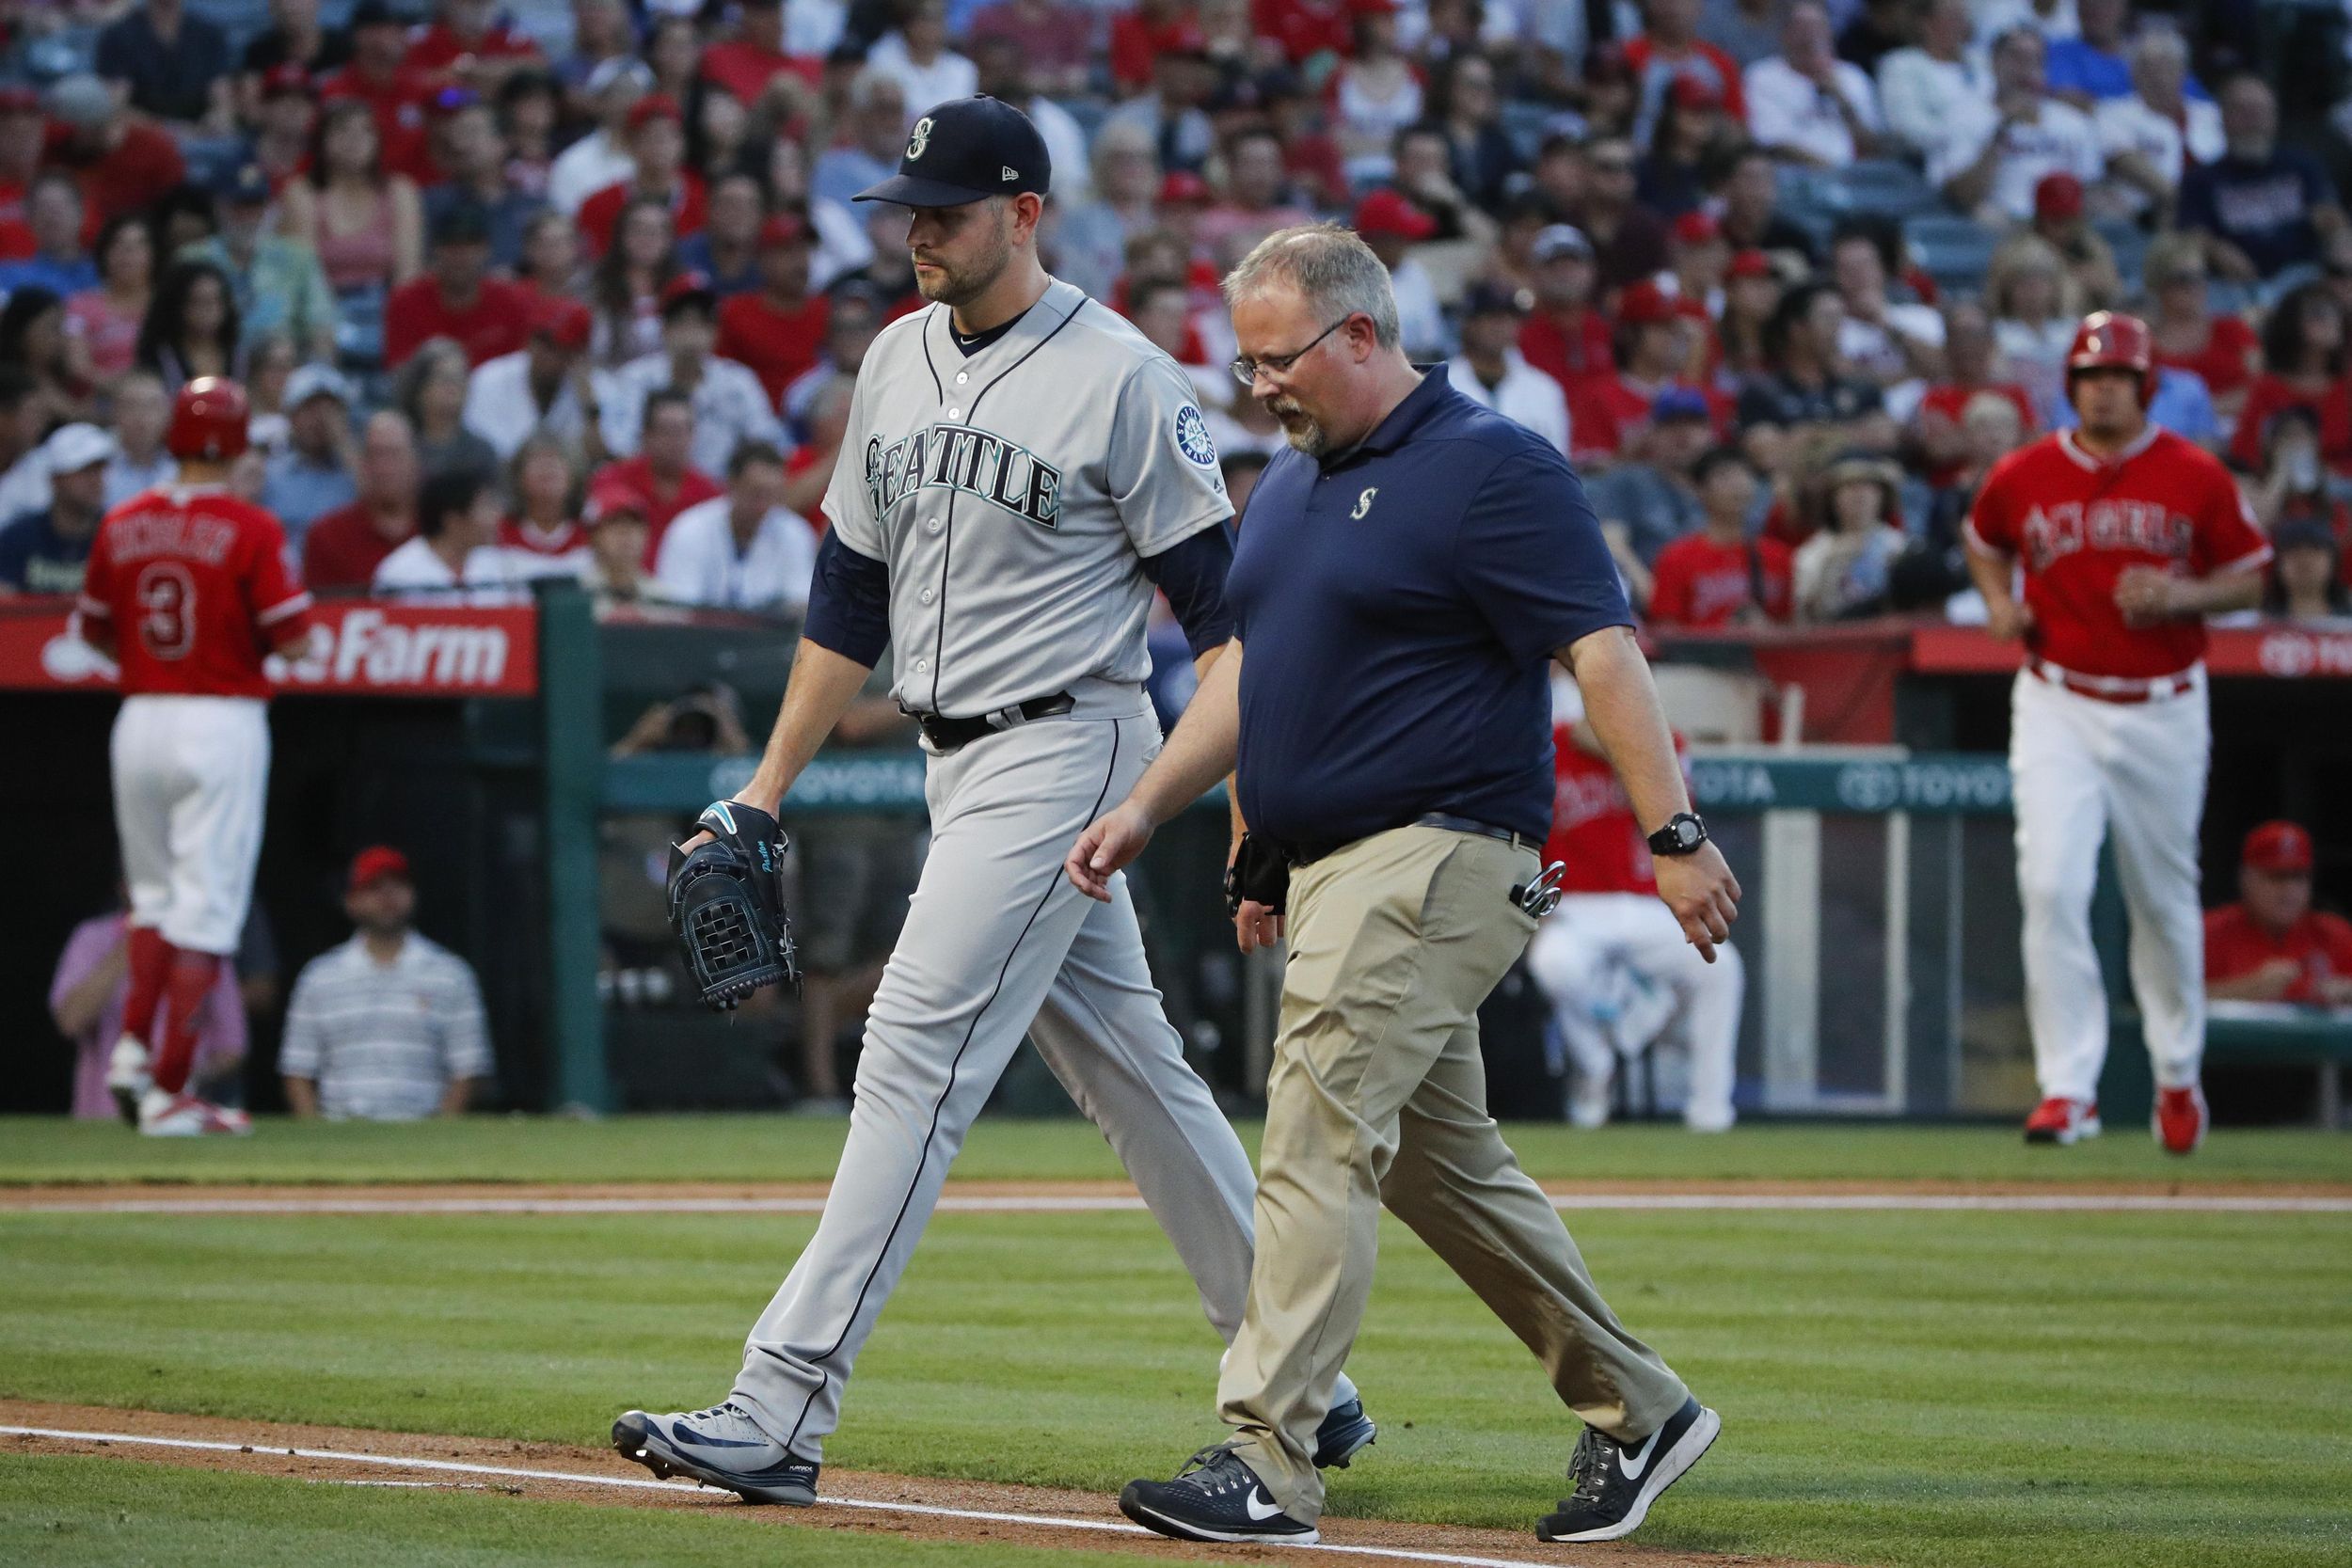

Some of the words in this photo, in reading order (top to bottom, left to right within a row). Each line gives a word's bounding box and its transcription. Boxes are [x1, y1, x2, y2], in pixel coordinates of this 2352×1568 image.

[906, 117, 937, 162] S
[865, 422, 1062, 531] SEATTLE
[1349, 486, 1379, 519] S
[136, 562, 196, 661] 3
[1902, 764, 2011, 806] TOYO
